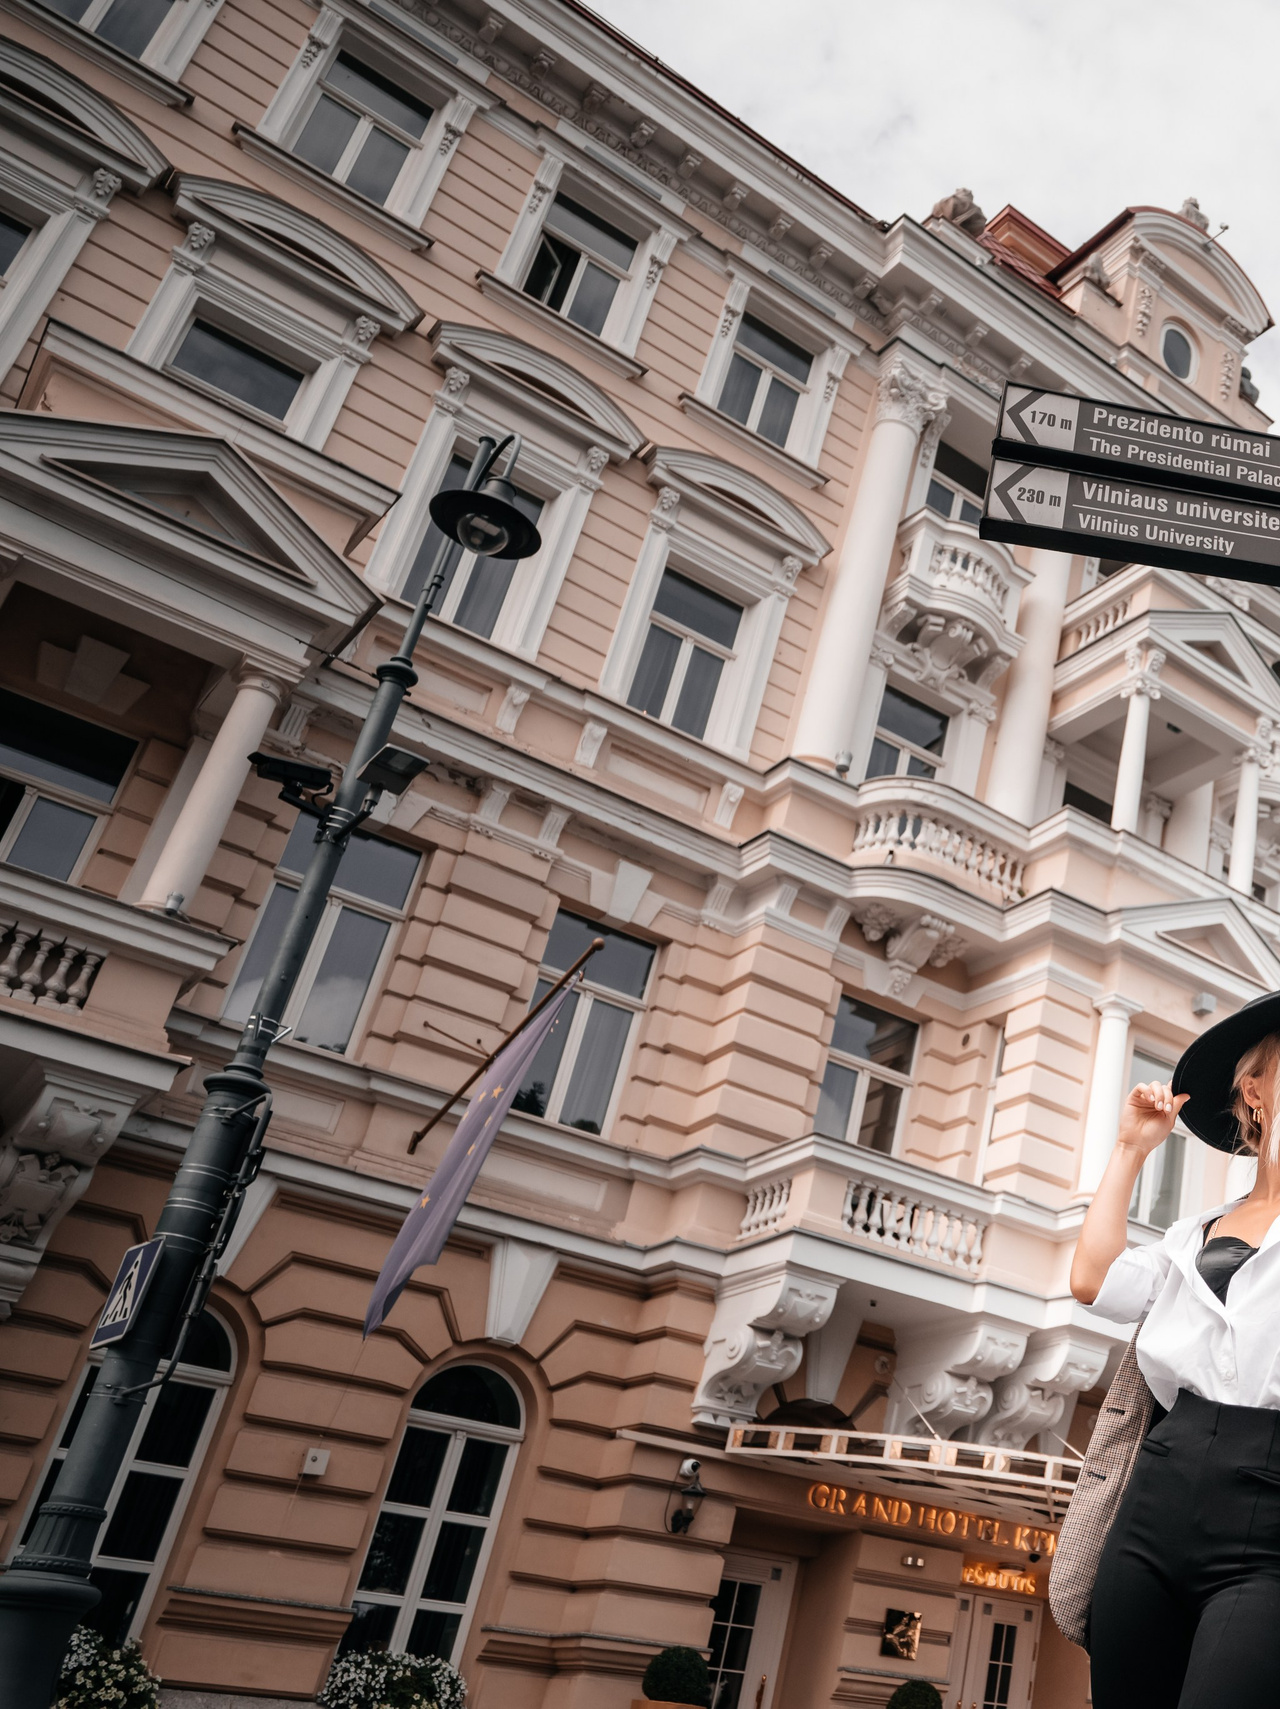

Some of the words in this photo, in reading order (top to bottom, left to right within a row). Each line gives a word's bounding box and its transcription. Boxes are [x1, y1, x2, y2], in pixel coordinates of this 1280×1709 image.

[1029, 409, 1057, 430] 170
[1060, 418, 1072, 431] m
[1092, 407, 1204, 445] Prezidento
[1211, 432, 1271, 458] rūmai
[1089, 436, 1121, 457] The
[1126, 444, 1231, 478] Presidential
[1016, 486, 1046, 506] 230
[1049, 495, 1061, 508] m
[1082, 481, 1169, 514] Vilniaus
[1078, 512, 1139, 538] Vilnius
[1145, 524, 1235, 556] University
[808, 1483, 912, 1525] GRAND
[918, 1506, 1009, 1546] HOTEL
